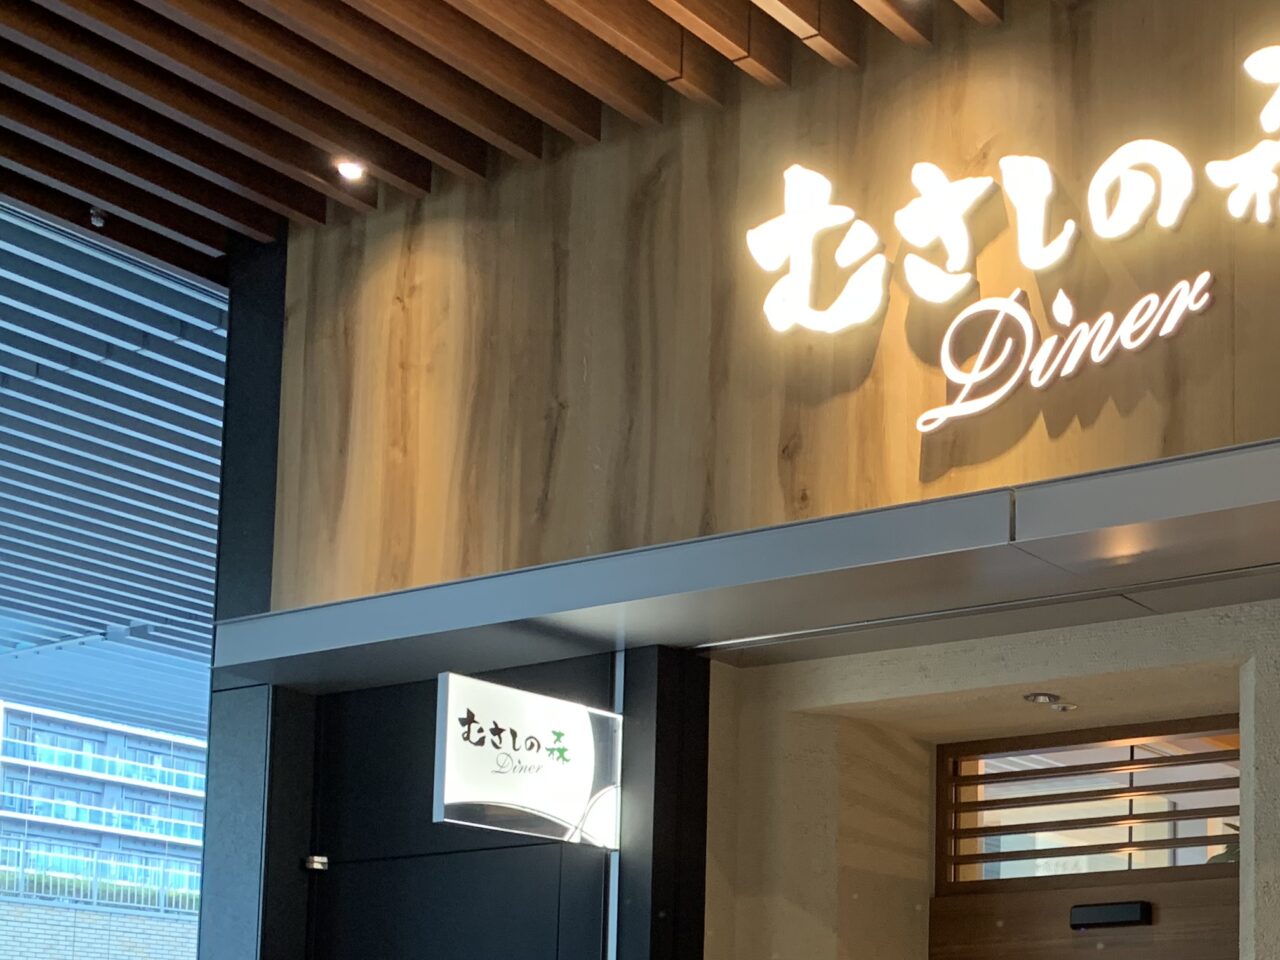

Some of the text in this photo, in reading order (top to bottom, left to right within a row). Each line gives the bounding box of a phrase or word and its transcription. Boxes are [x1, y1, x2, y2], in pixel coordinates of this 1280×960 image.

[915, 270, 1213, 432] Diner
[458, 708, 571, 765] むさしの森
[491, 752, 544, 774] Diner
